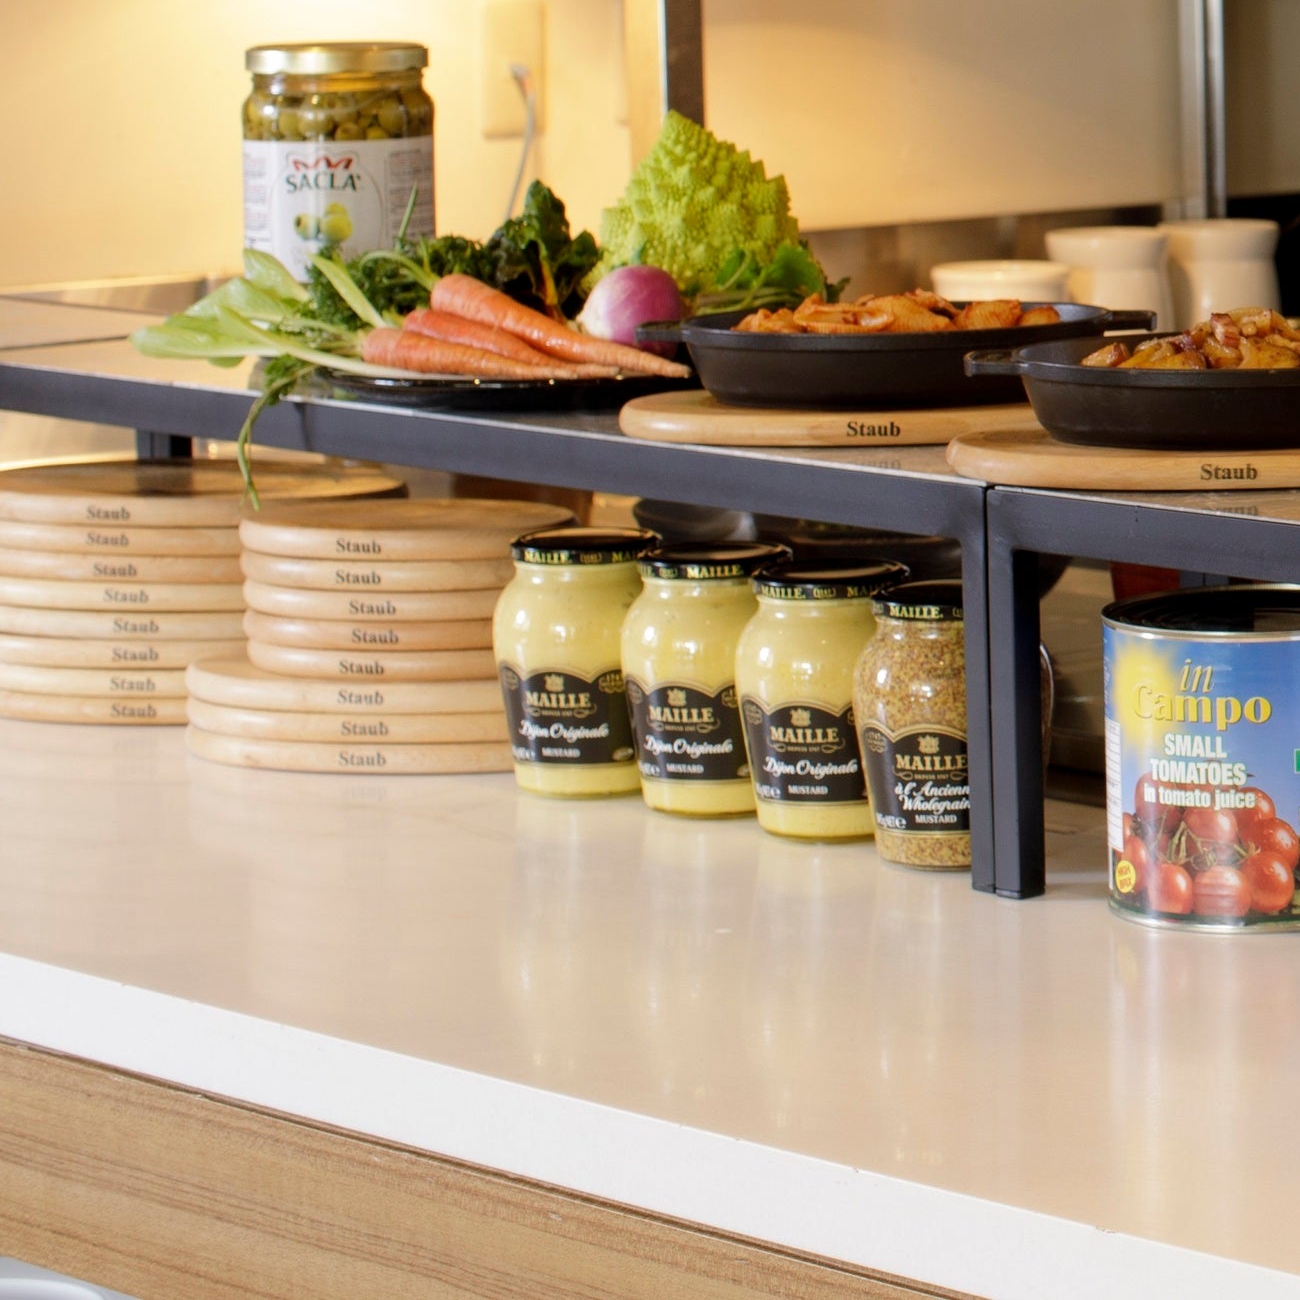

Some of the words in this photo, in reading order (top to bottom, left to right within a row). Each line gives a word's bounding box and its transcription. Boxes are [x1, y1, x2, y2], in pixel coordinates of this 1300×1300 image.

[846, 421, 901, 437] Staub
[1200, 463, 1258, 480] Staub
[86, 506, 130, 521] Staub
[86, 531, 130, 547] Staub
[336, 539, 381, 554] Staub
[93, 562, 137, 577] Staub
[336, 571, 381, 586] Staub
[103, 588, 149, 604] Staub
[349, 601, 396, 616] Staub
[113, 618, 159, 634] Staub
[351, 629, 399, 645] Staub
[112, 646, 159, 662] Staub
[339, 660, 384, 675] Staub
[1179, 658, 1215, 693] in
[110, 676, 156, 692] Staub
[338, 690, 384, 706] Staub
[526, 691, 591, 709] MAILLE
[111, 703, 157, 718] Staub
[649, 706, 715, 724] MAILLE
[1131, 682, 1273, 732] Campo
[341, 721, 389, 737] Staub
[770, 726, 839, 743] MAILLE
[673, 738, 733, 759] Originale
[1164, 733, 1228, 759] SMALL
[339, 751, 387, 768] Staub
[896, 754, 968, 771] MAILLE
[763, 756, 795, 778] Dijon
[796, 759, 858, 780] Originale
[1150, 758, 1247, 786] TOMATOES
[788, 784, 828, 795] MUSTARD
[1144, 783, 1156, 803] in
[1158, 786, 1212, 809] tomato
[1214, 788, 1256, 812] juice
[915, 813, 957, 825] MUSTARD
